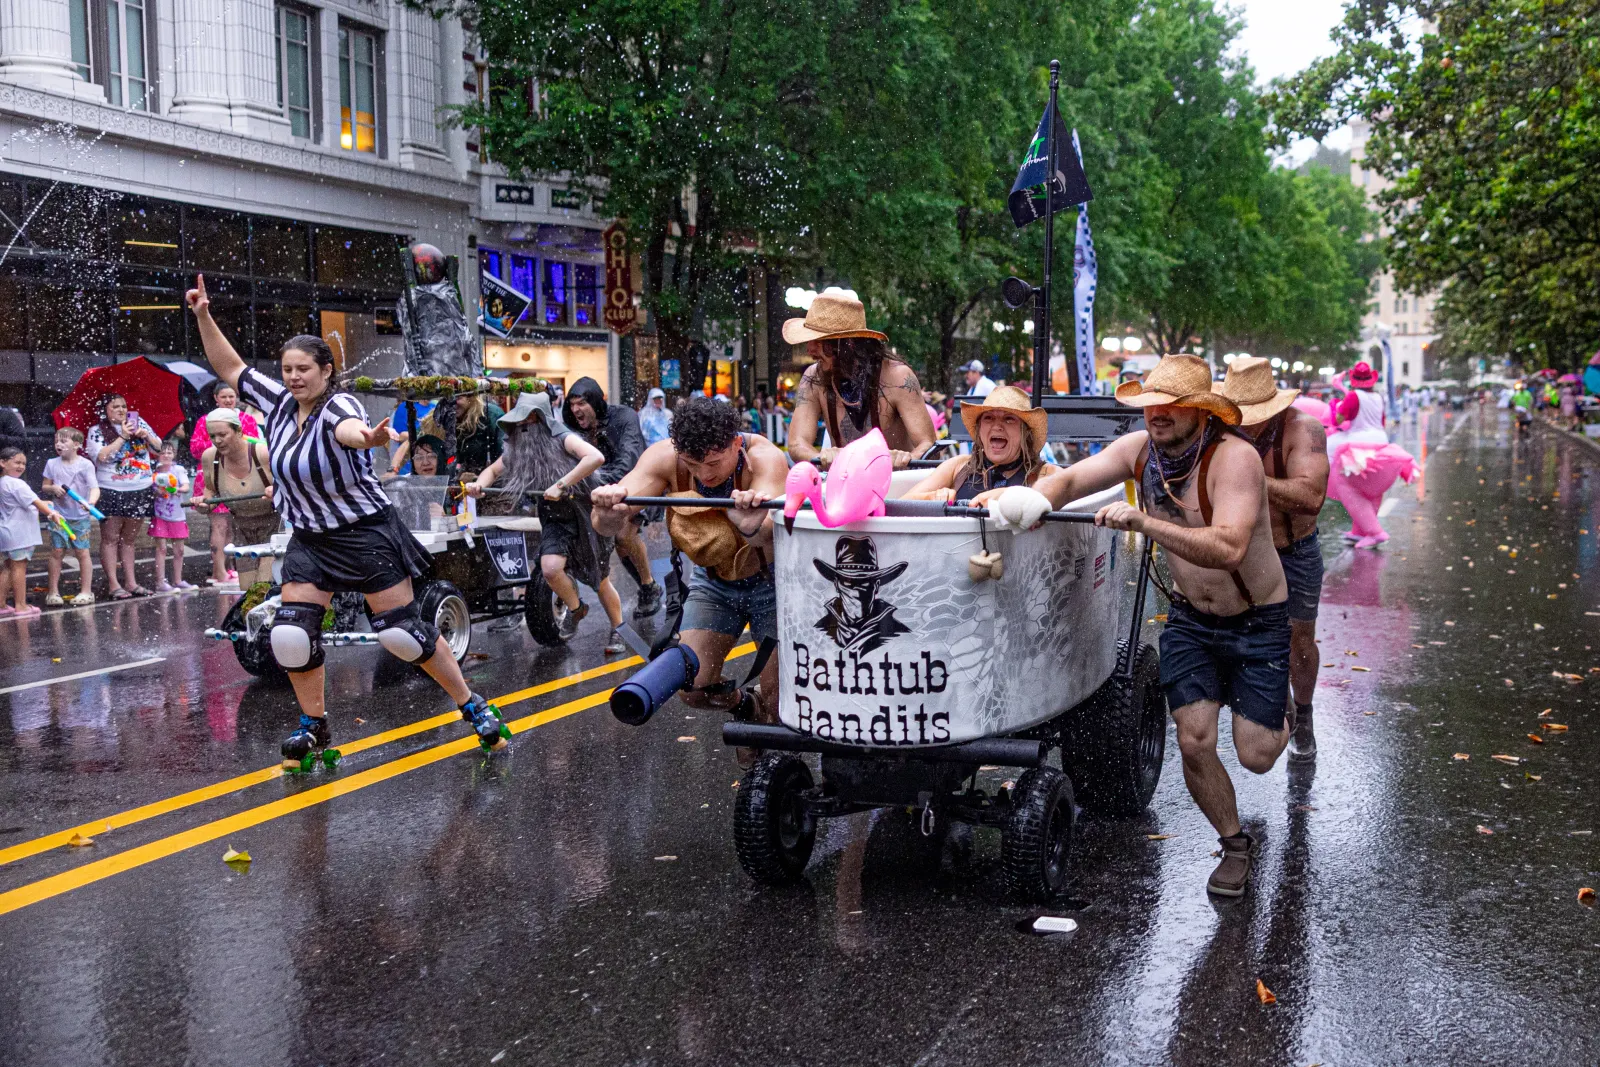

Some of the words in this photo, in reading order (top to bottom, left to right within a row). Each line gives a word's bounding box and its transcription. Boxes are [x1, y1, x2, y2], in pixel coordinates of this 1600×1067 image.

[495, 286, 507, 297] THE
[610, 230, 627, 306] OHIO
[606, 308, 634, 320] CLUB
[793, 641, 950, 695] Bathtub
[795, 694, 951, 746] Bandits
